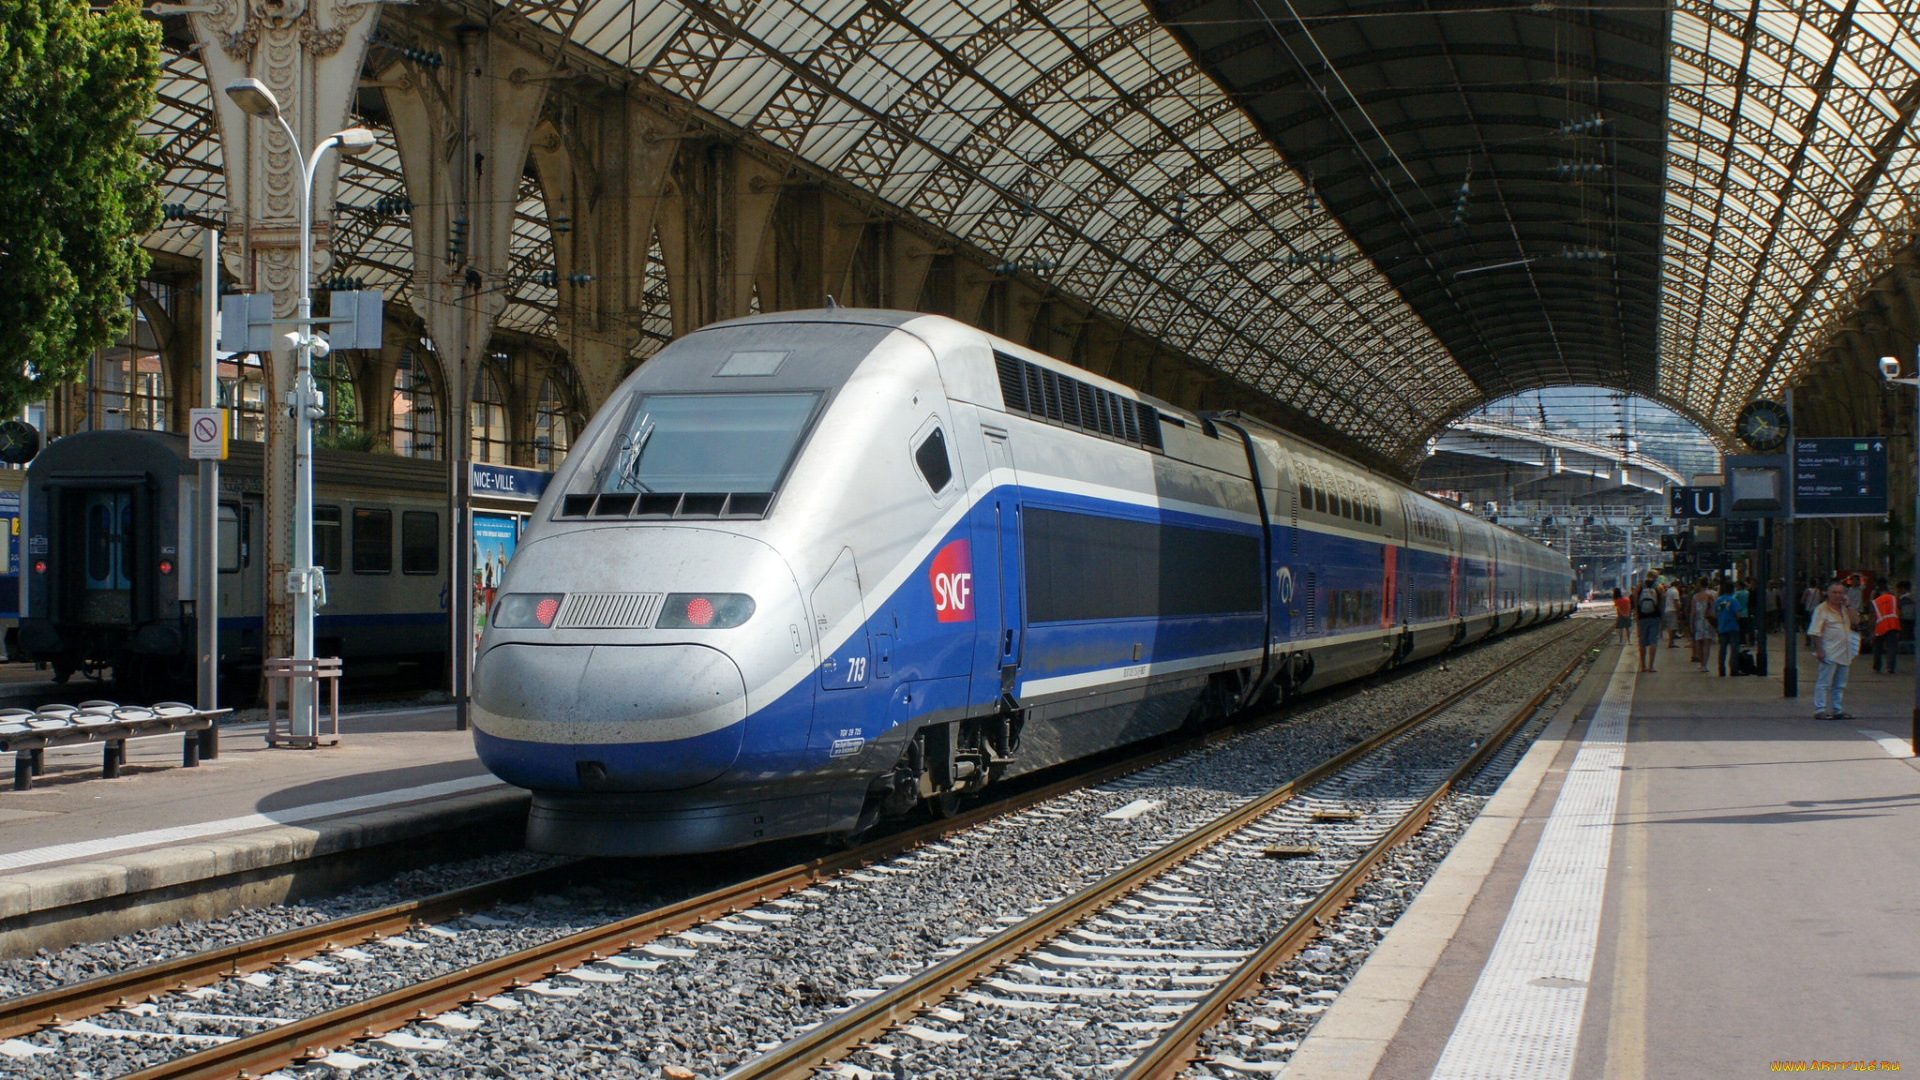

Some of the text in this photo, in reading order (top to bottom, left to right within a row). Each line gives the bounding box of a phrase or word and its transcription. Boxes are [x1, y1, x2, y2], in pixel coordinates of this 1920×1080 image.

[473, 470, 514, 491] NICE-VILLE
[1673, 492, 1682, 500] A
[1693, 491, 1715, 516] U
[1672, 537, 1685, 551] V
[935, 573, 971, 611] SNCF
[847, 657, 866, 683] 713
